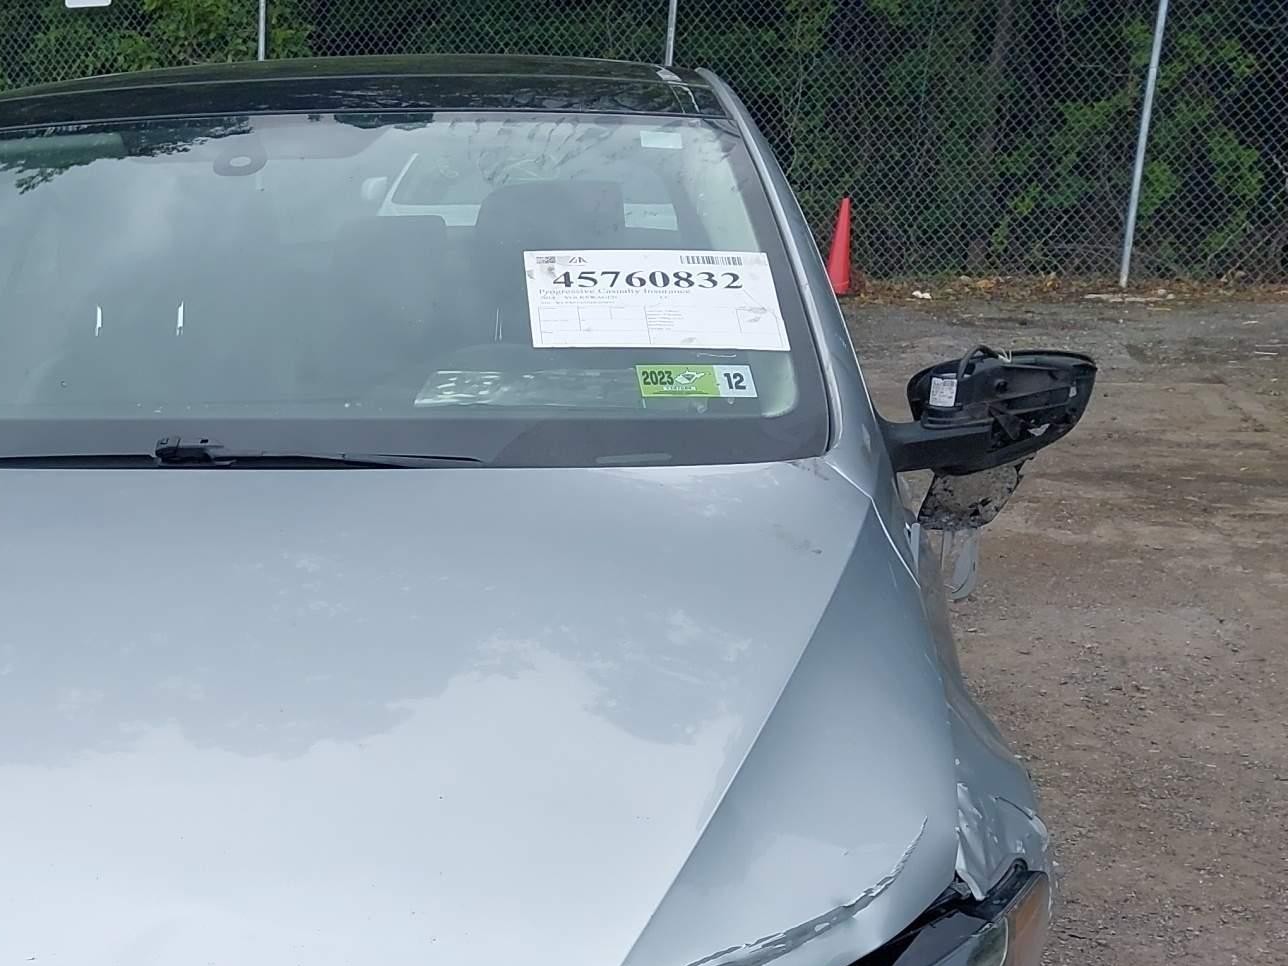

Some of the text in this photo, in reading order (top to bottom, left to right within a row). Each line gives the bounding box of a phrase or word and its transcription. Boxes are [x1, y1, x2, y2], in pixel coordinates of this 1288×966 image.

[552, 270, 743, 289] 45760832
[641, 370, 747, 390] 2023 12
